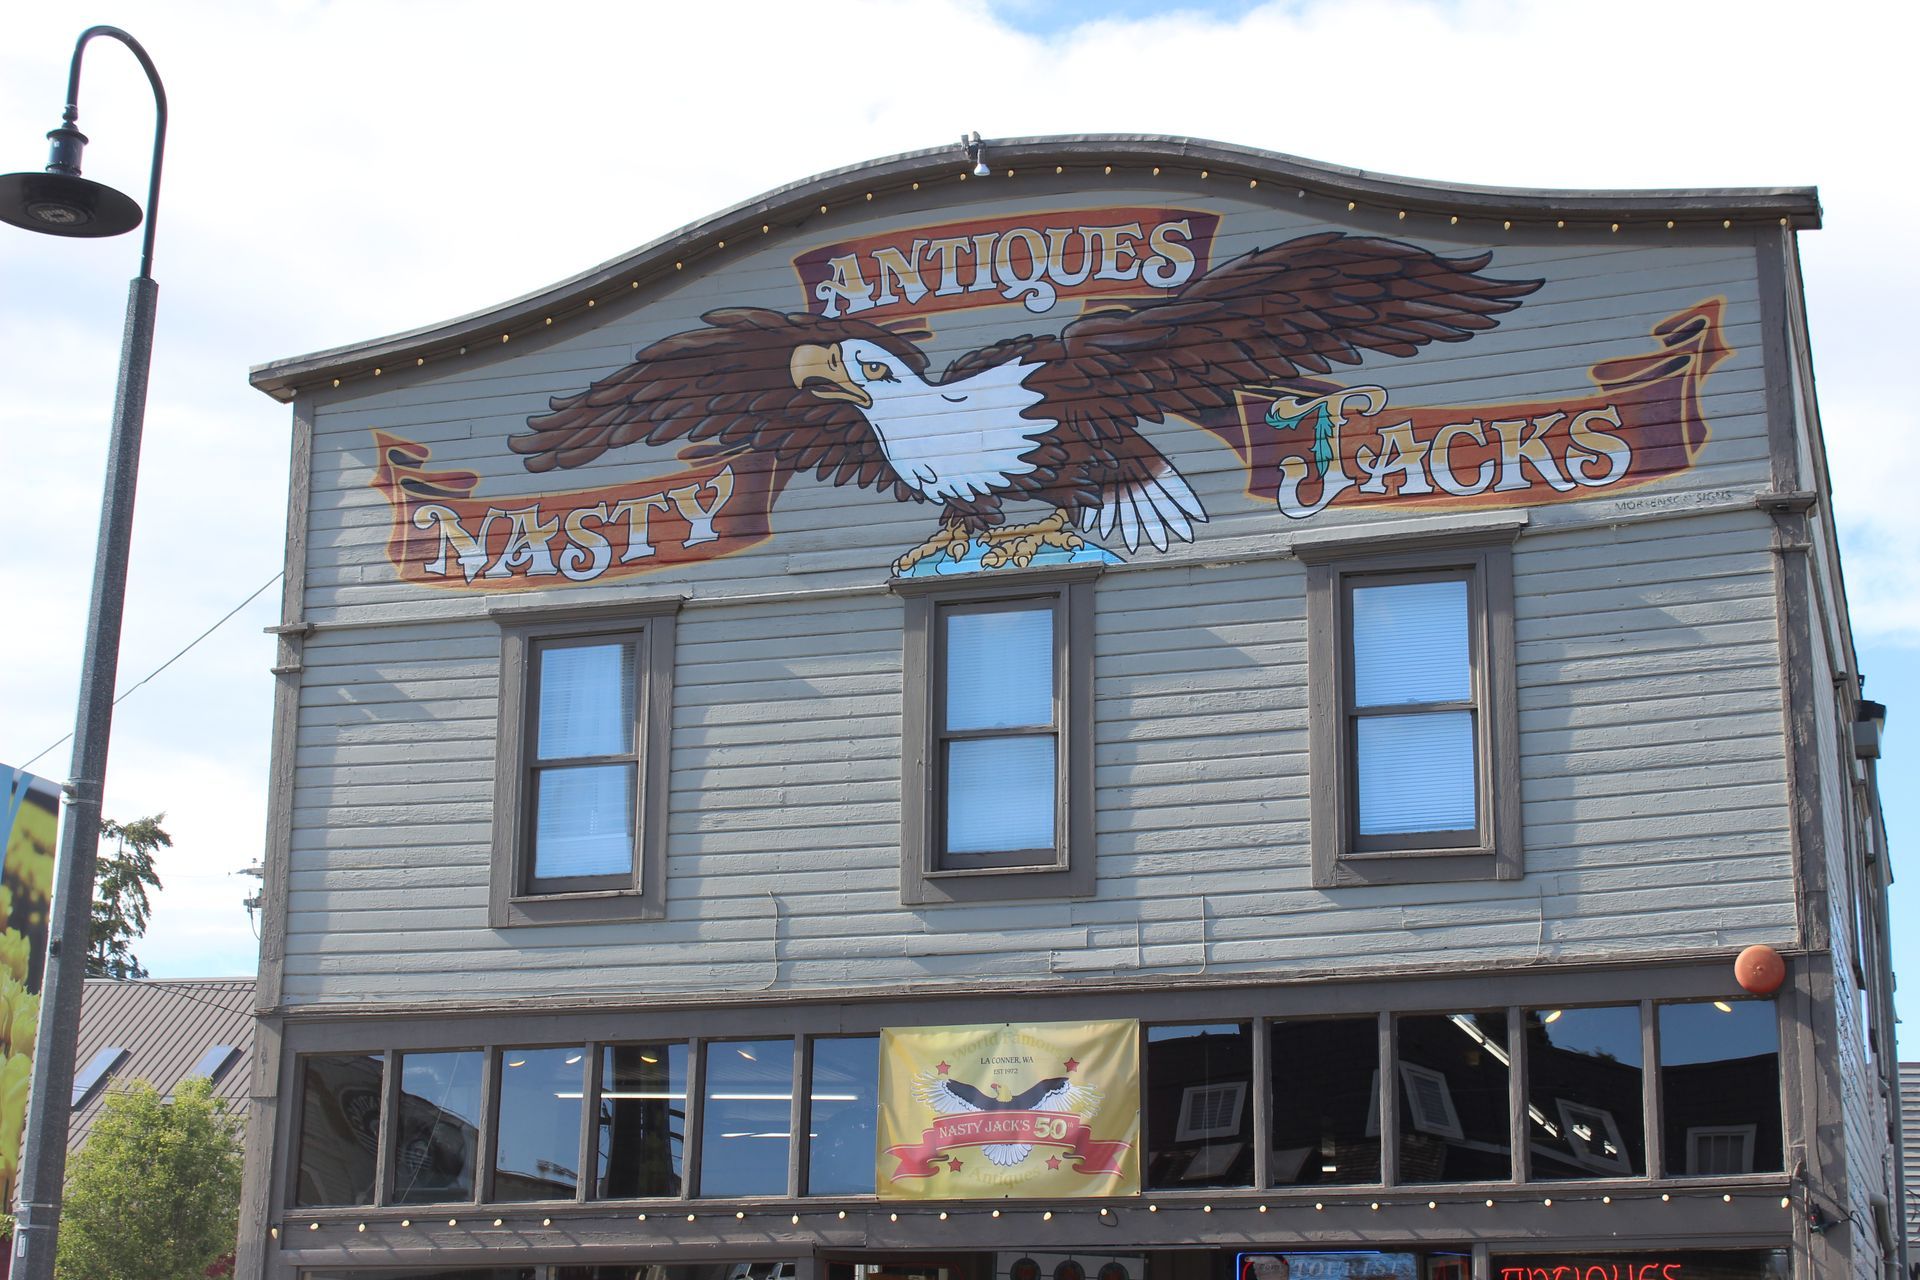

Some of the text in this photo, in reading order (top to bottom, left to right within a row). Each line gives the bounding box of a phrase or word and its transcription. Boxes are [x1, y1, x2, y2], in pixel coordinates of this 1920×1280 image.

[816, 218, 1197, 318] ANTIQUES
[1264, 384, 1633, 519] JACKS
[412, 463, 734, 584] NASTY
[980, 1056, 1034, 1065] LA CONNER, WA
[939, 1119, 983, 1139] NASTY
[984, 1119, 1031, 1133] JACK'S
[969, 1167, 1041, 1188] Antiques
